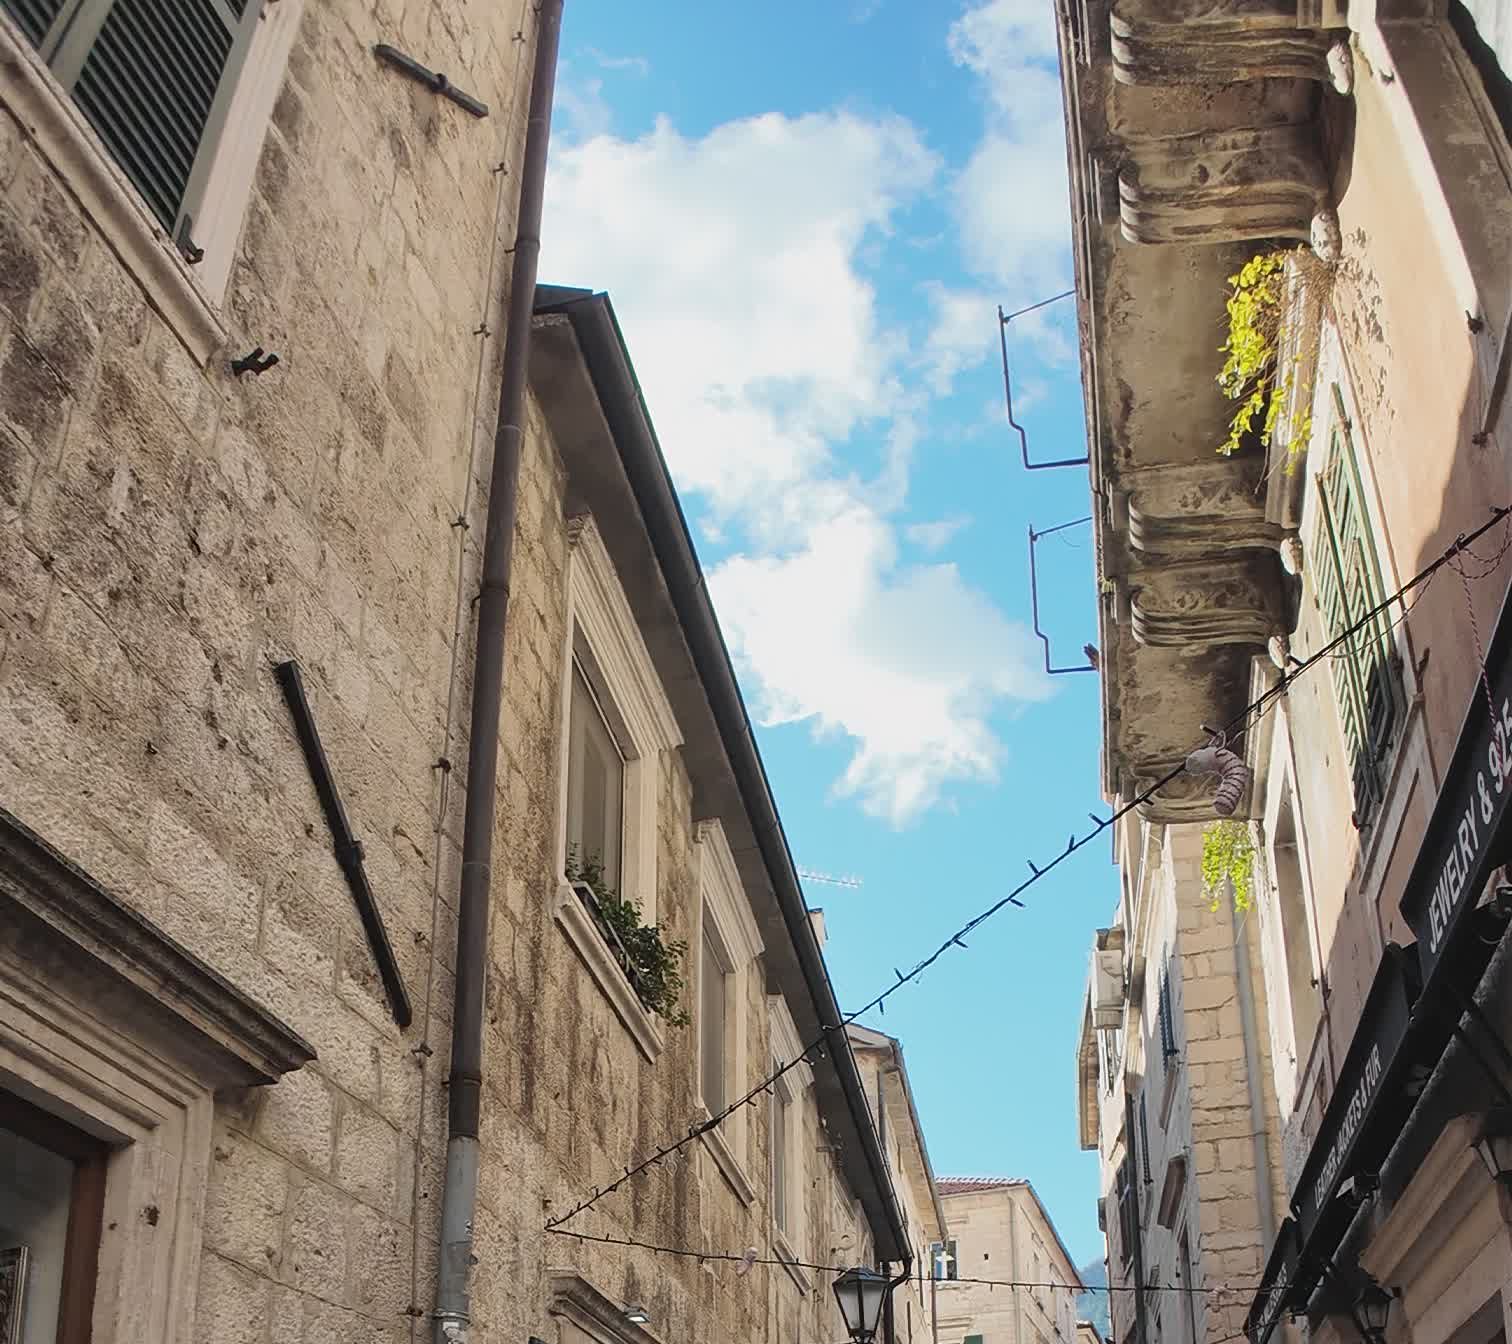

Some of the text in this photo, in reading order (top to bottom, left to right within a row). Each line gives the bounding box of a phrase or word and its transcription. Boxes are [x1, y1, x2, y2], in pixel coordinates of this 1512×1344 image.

[1427, 795, 1479, 953] JEWELRY
[1476, 771, 1494, 825] &
[1314, 1145, 1338, 1209] LEATHER
[1336, 1089, 1362, 1165] JACKETS
[1365, 1042, 1382, 1096] FUR
